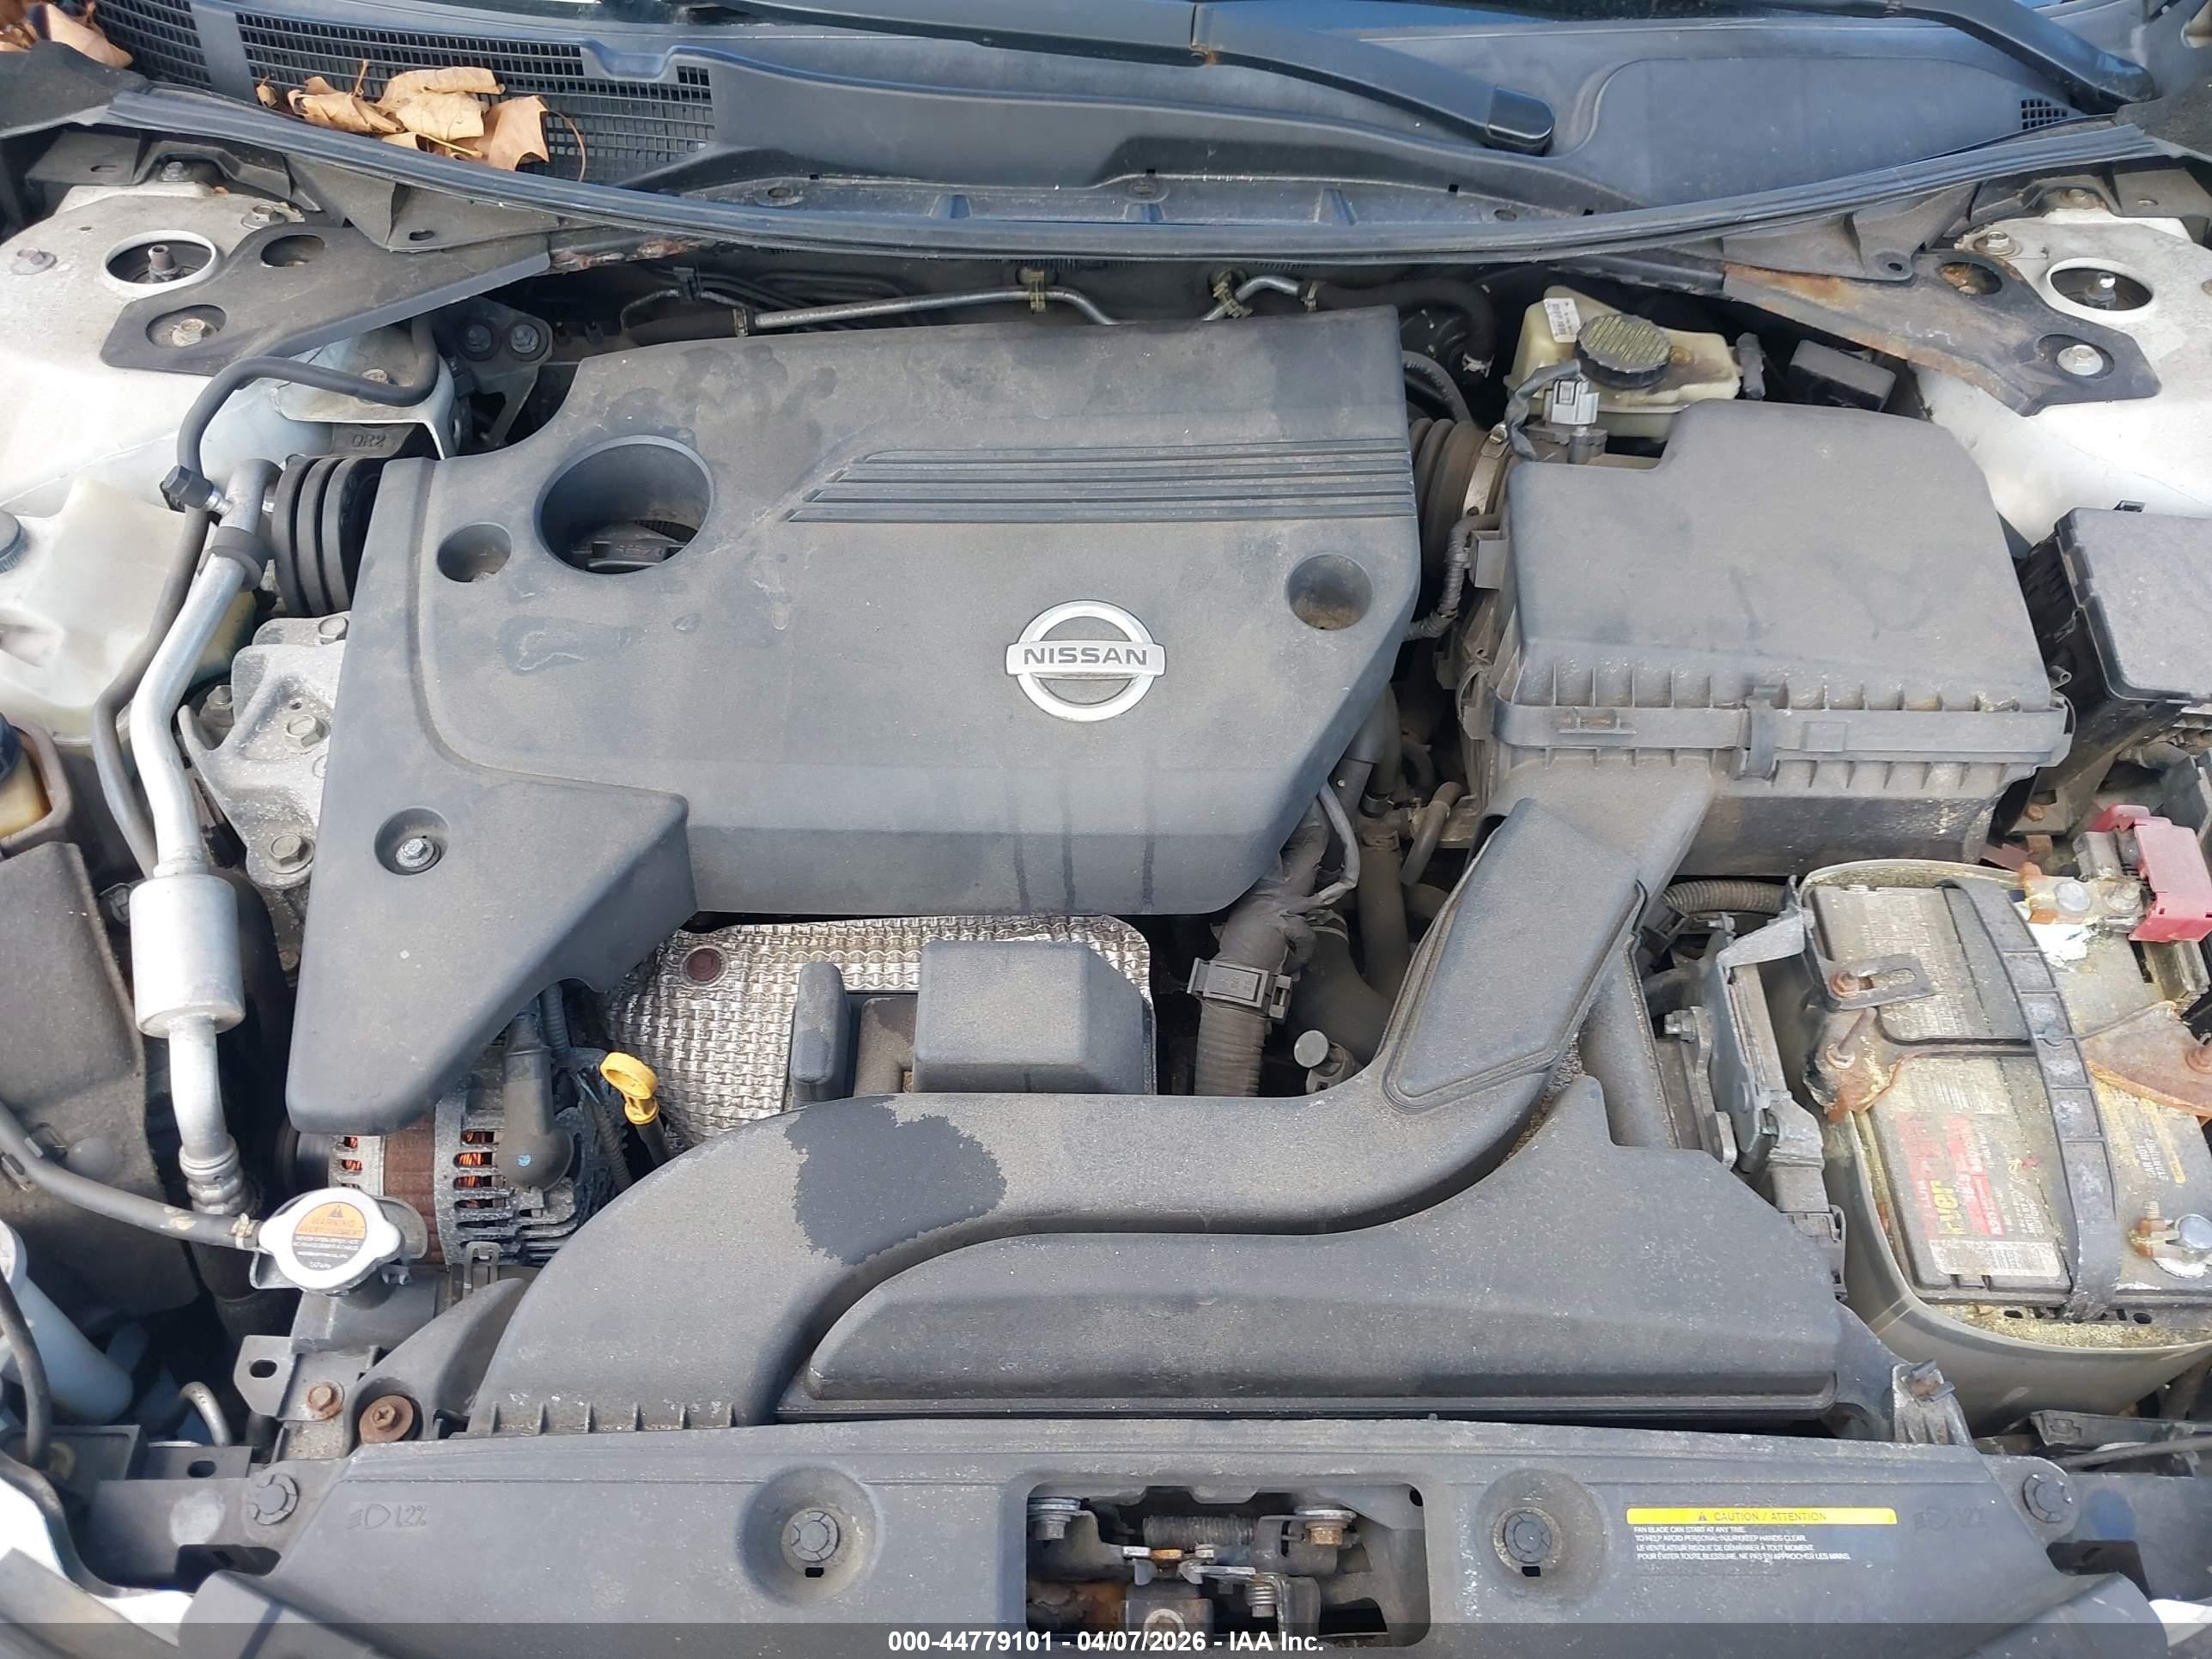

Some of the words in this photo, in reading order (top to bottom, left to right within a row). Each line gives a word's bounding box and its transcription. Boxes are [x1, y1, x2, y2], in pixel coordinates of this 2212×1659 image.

[1024, 647, 1147, 665] NISSAN
[1714, 1512, 1759, 1521] CAUTION
[1771, 1512, 1826, 1522] ATTENTION
